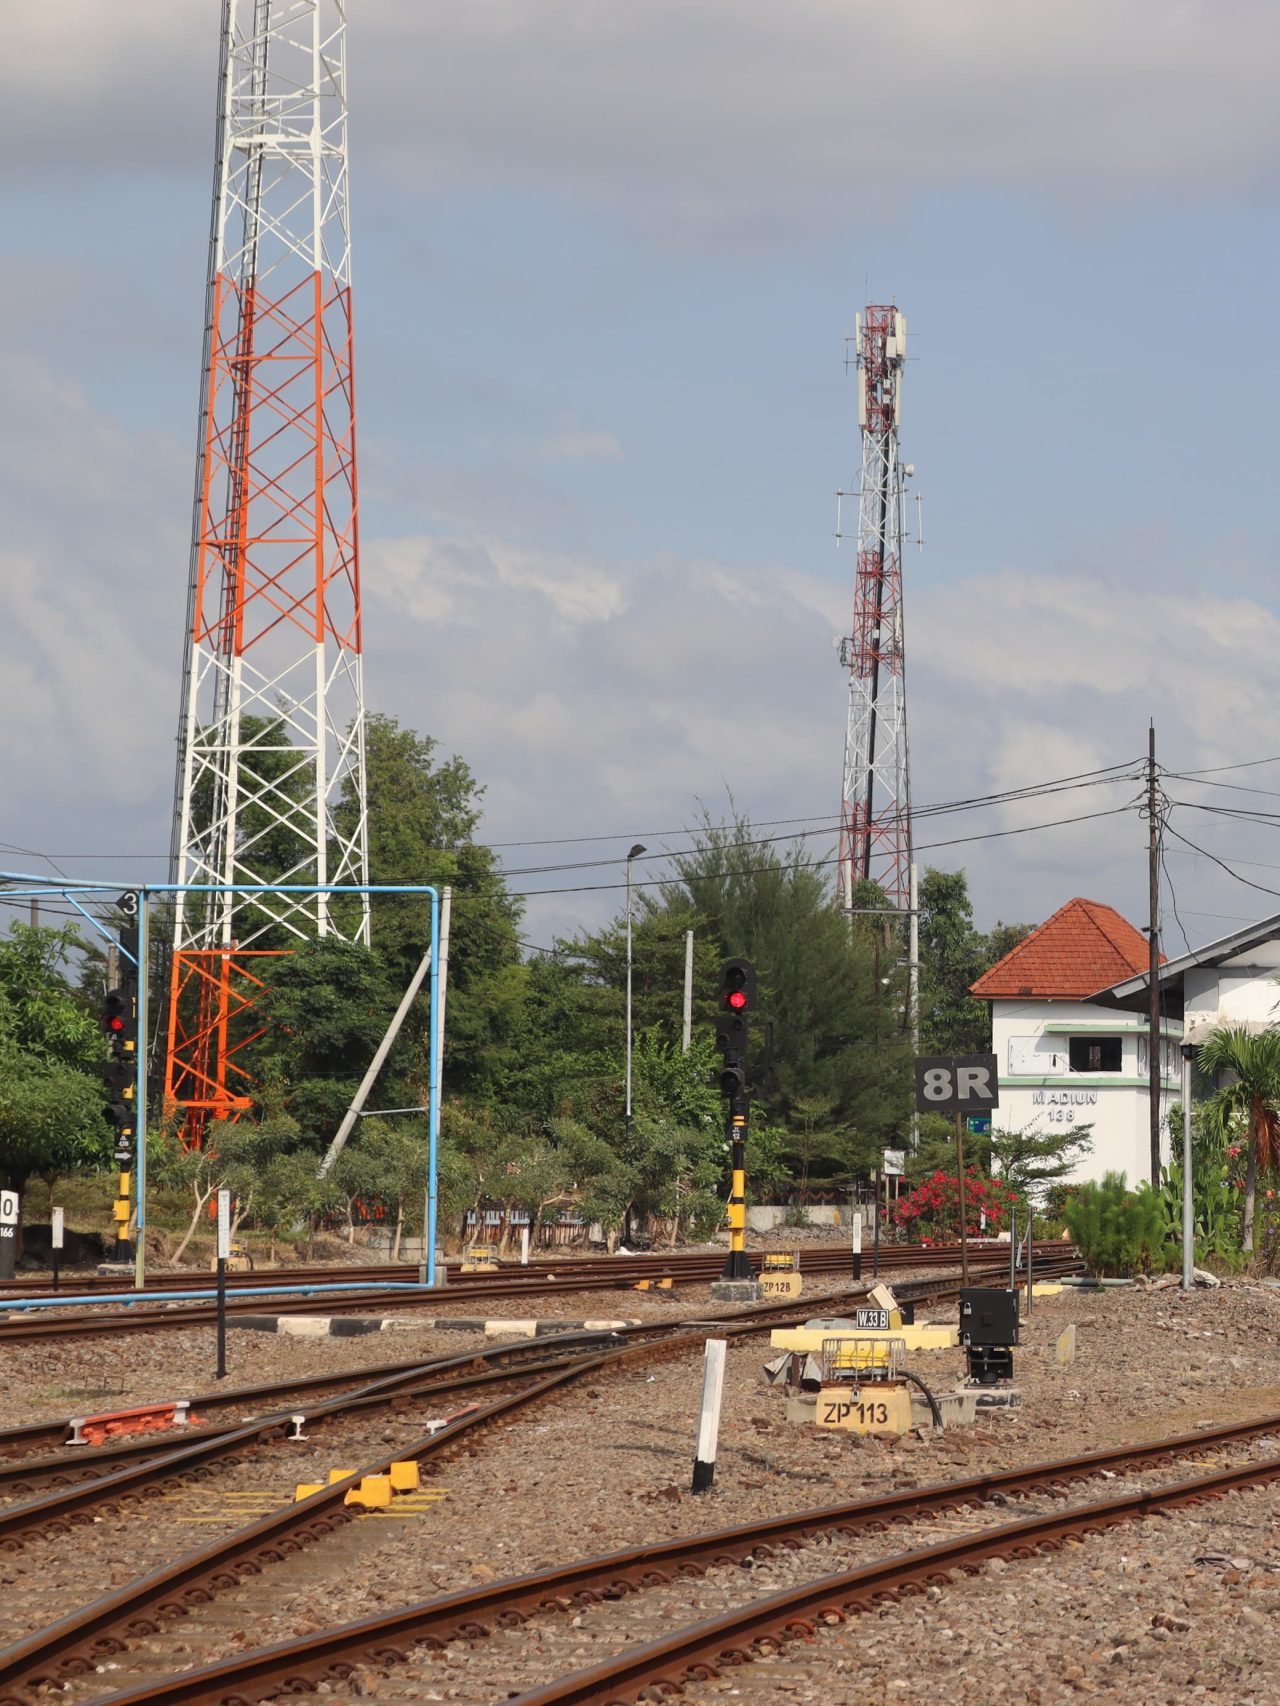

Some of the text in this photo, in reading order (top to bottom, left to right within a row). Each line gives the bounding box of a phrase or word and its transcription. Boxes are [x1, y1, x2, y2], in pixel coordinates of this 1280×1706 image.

[123, 892, 138, 914] 3
[923, 1066, 993, 1101] 8R
[1032, 1090, 1098, 1105] MADIUN
[1048, 1109, 1075, 1122] 138
[3, 1198, 13, 1217] 0
[880, 1311, 887, 1327] B
[823, 1403, 888, 1424] ZP 113
